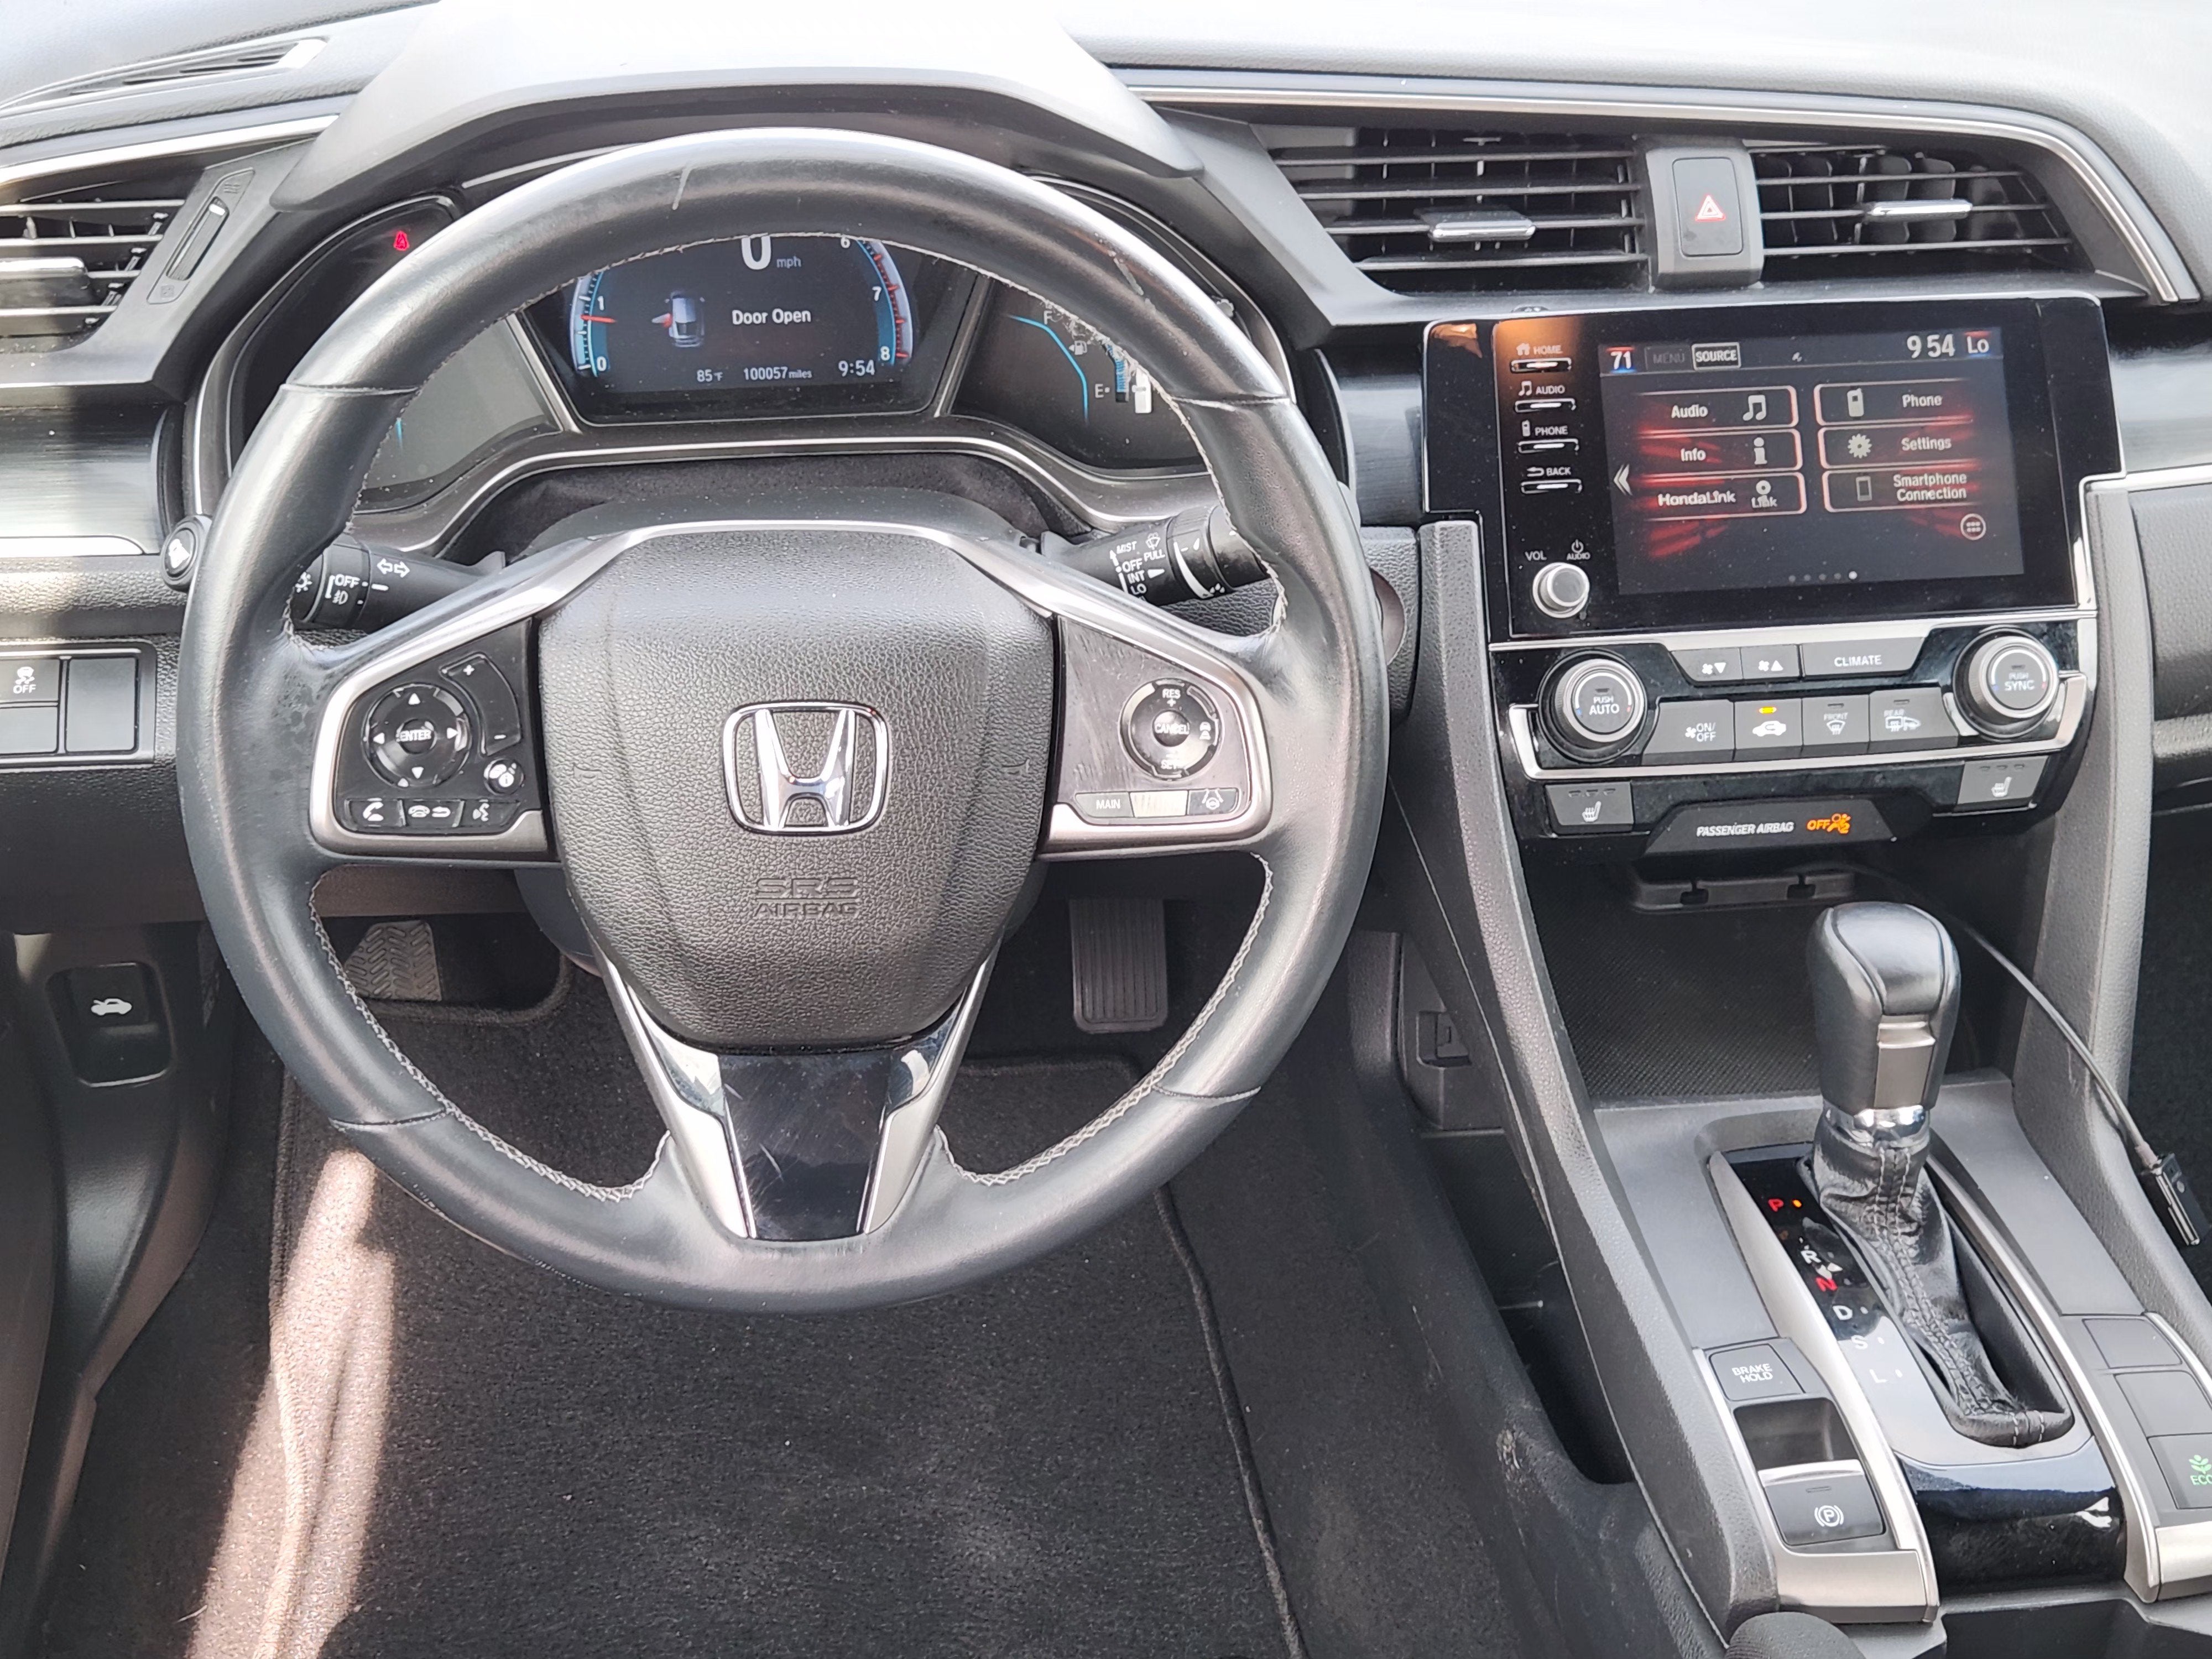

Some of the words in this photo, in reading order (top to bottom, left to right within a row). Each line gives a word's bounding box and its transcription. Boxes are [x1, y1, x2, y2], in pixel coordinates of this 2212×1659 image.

[841, 237, 851, 248] 6
[776, 255, 802, 269] mph
[872, 286, 881, 301] 7
[598, 296, 604, 311] 1
[732, 310, 769, 325] Door
[772, 308, 812, 325] Open
[1044, 310, 1052, 325] F
[1533, 345, 1563, 355] HOME
[1967, 336, 1989, 354] Lo
[880, 347, 889, 361] 8
[1610, 351, 1632, 369] 71
[1695, 349, 1738, 363] SOURCE
[597, 356, 607, 372] 0
[838, 360, 875, 378] 9:54
[743, 366, 788, 381] 100057
[788, 369, 812, 379] miles
[1095, 384, 1104, 398] E
[1535, 384, 1566, 394] AUDIO
[1902, 394, 1943, 408] Phone
[1671, 404, 1708, 419] Audio
[1535, 425, 1568, 436] PHONE
[1901, 437, 1952, 451] Settings
[1681, 448, 1706, 462] Info
[1546, 467, 1572, 477] BACK
[1893, 472, 1968, 489] Smartphone
[1658, 490, 1736, 507] HondaLink
[1897, 487, 1967, 502] Connection
[1116, 541, 1137, 554] MIST
[1143, 549, 1166, 562] PULL
[1525, 551, 1547, 561] VOL
[1121, 557, 1142, 573] OFF
[335, 573, 361, 588] OFF
[1127, 570, 1145, 584] INT
[1130, 583, 1147, 595] LO
[1834, 655, 1882, 667] CLIMATE
[13, 684, 36, 695] OFF
[2005, 680, 2034, 691] SYNC
[1162, 688, 1181, 699] RES
[1593, 696, 1614, 705] PUSH
[1589, 704, 1620, 715] AUTO
[1696, 723, 1716, 732] ON/
[1696, 732, 1717, 742] OFF
[1096, 800, 1121, 809] MAIN
[1697, 823, 1755, 837] PASSENGER
[1756, 822, 1794, 834] AIRBAG
[1807, 820, 1830, 831] OFF
[1801, 1250, 1822, 1264] R
[1833, 1305, 1853, 1321] D
[1851, 1335, 1868, 1349] S
[1731, 1363, 1773, 1376] BRAKE
[1869, 1369, 1887, 1383] L
[1739, 1371, 1773, 1383] HOLD
